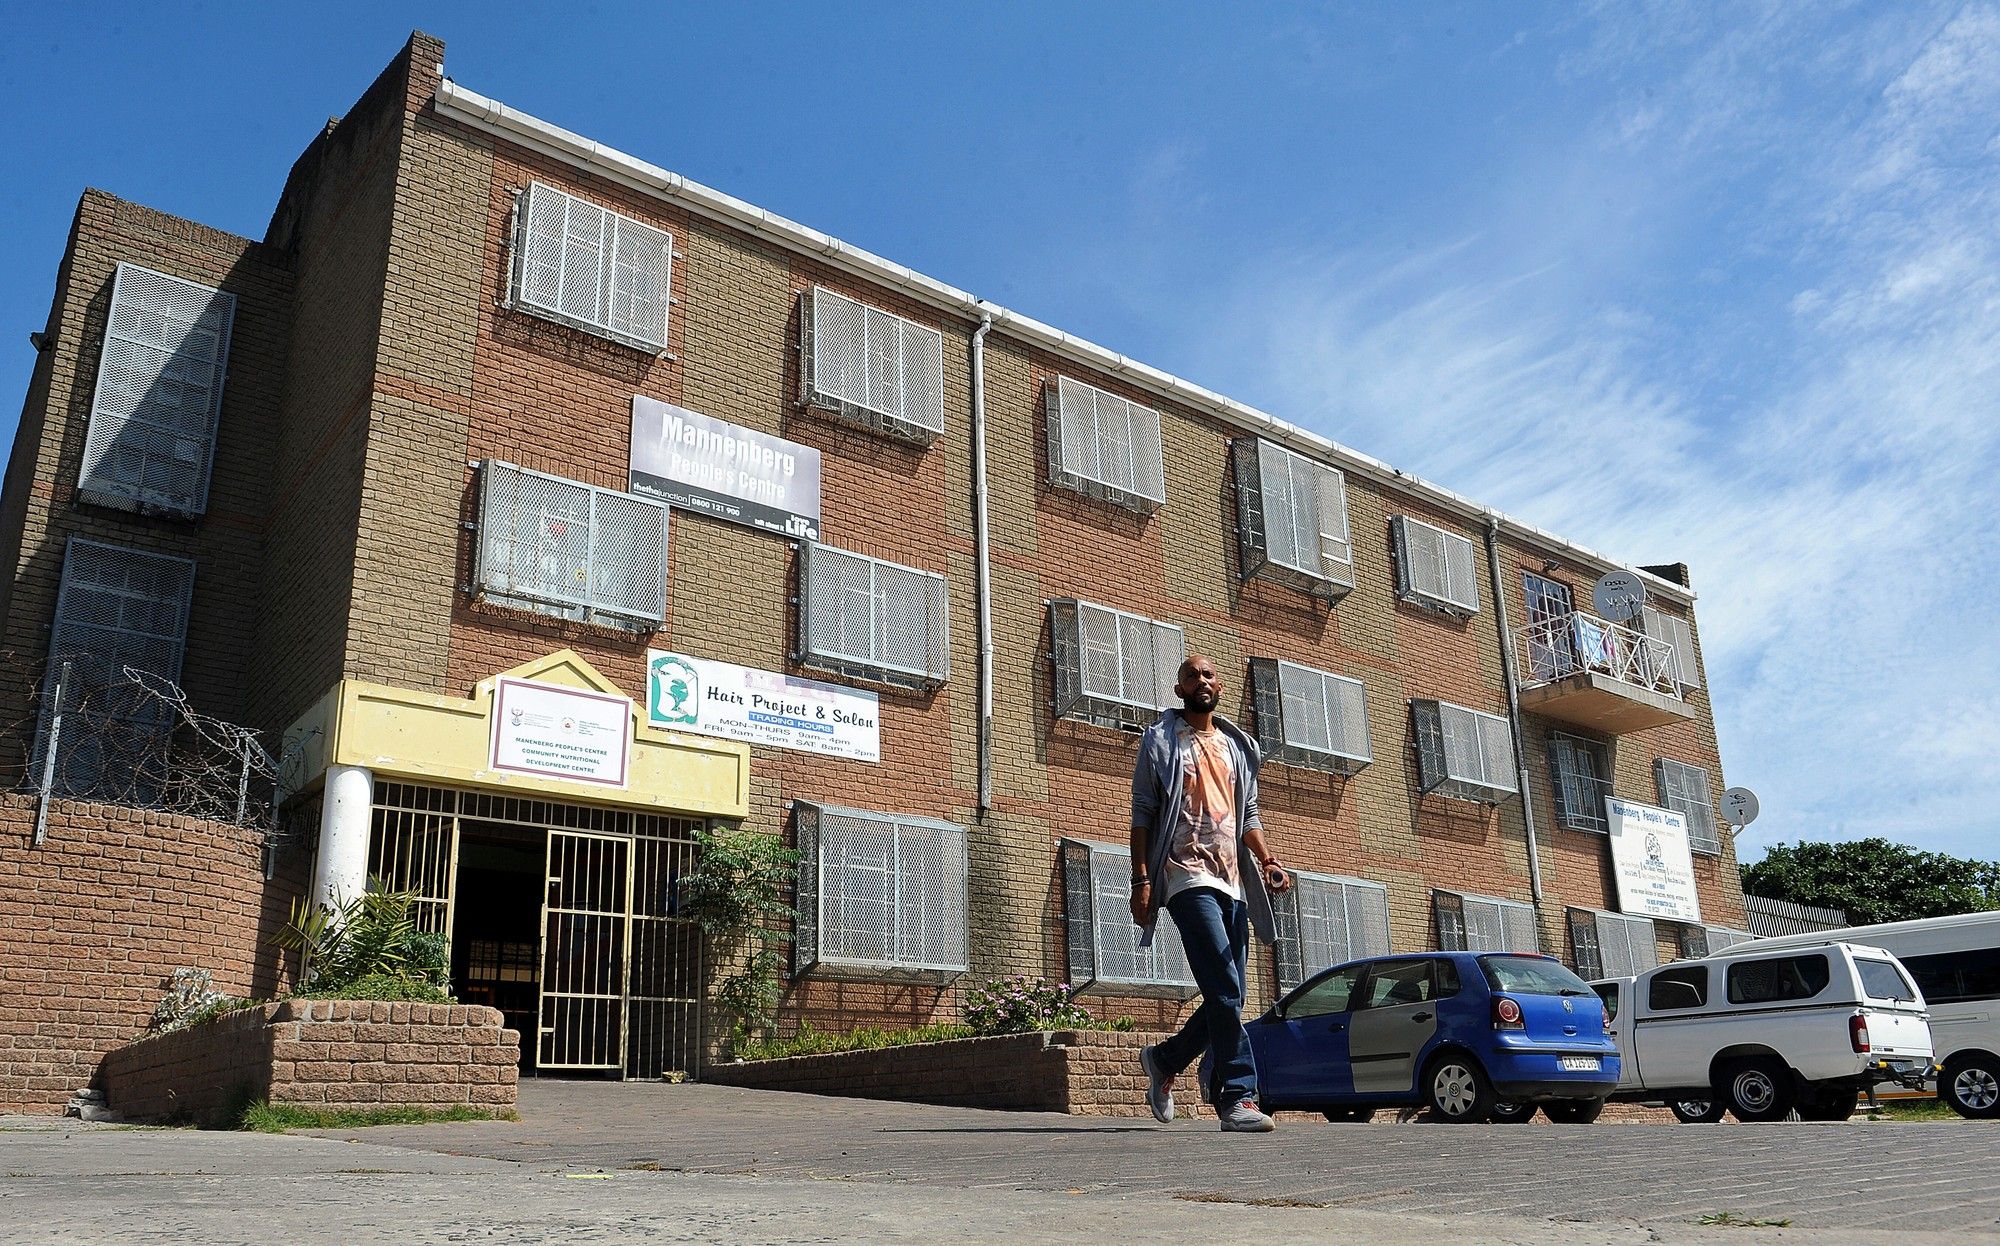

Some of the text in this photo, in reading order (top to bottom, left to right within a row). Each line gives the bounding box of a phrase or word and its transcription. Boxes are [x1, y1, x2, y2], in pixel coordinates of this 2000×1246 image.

[662, 413, 795, 477] Mannenberg
[671, 453, 786, 499] People's Centre
[691, 498, 741, 517] 0800 121 900
[785, 519, 818, 541] Life
[707, 686, 874, 728] Hair Project & Salon
[751, 713, 833, 733] TRADING HOURS:
[515, 737, 608, 756] MANENBERG PEOPLE'S CENTRE
[730, 728, 754, 737] 9am
[766, 734, 789, 744] 5pm
[821, 743, 843, 752] 8am
[854, 748, 876, 758] 2pm
[522, 748, 601, 765] COMMUNITY NUTRITIONAL
[526, 758, 595, 774] DEVELOPMENT CENTRE
